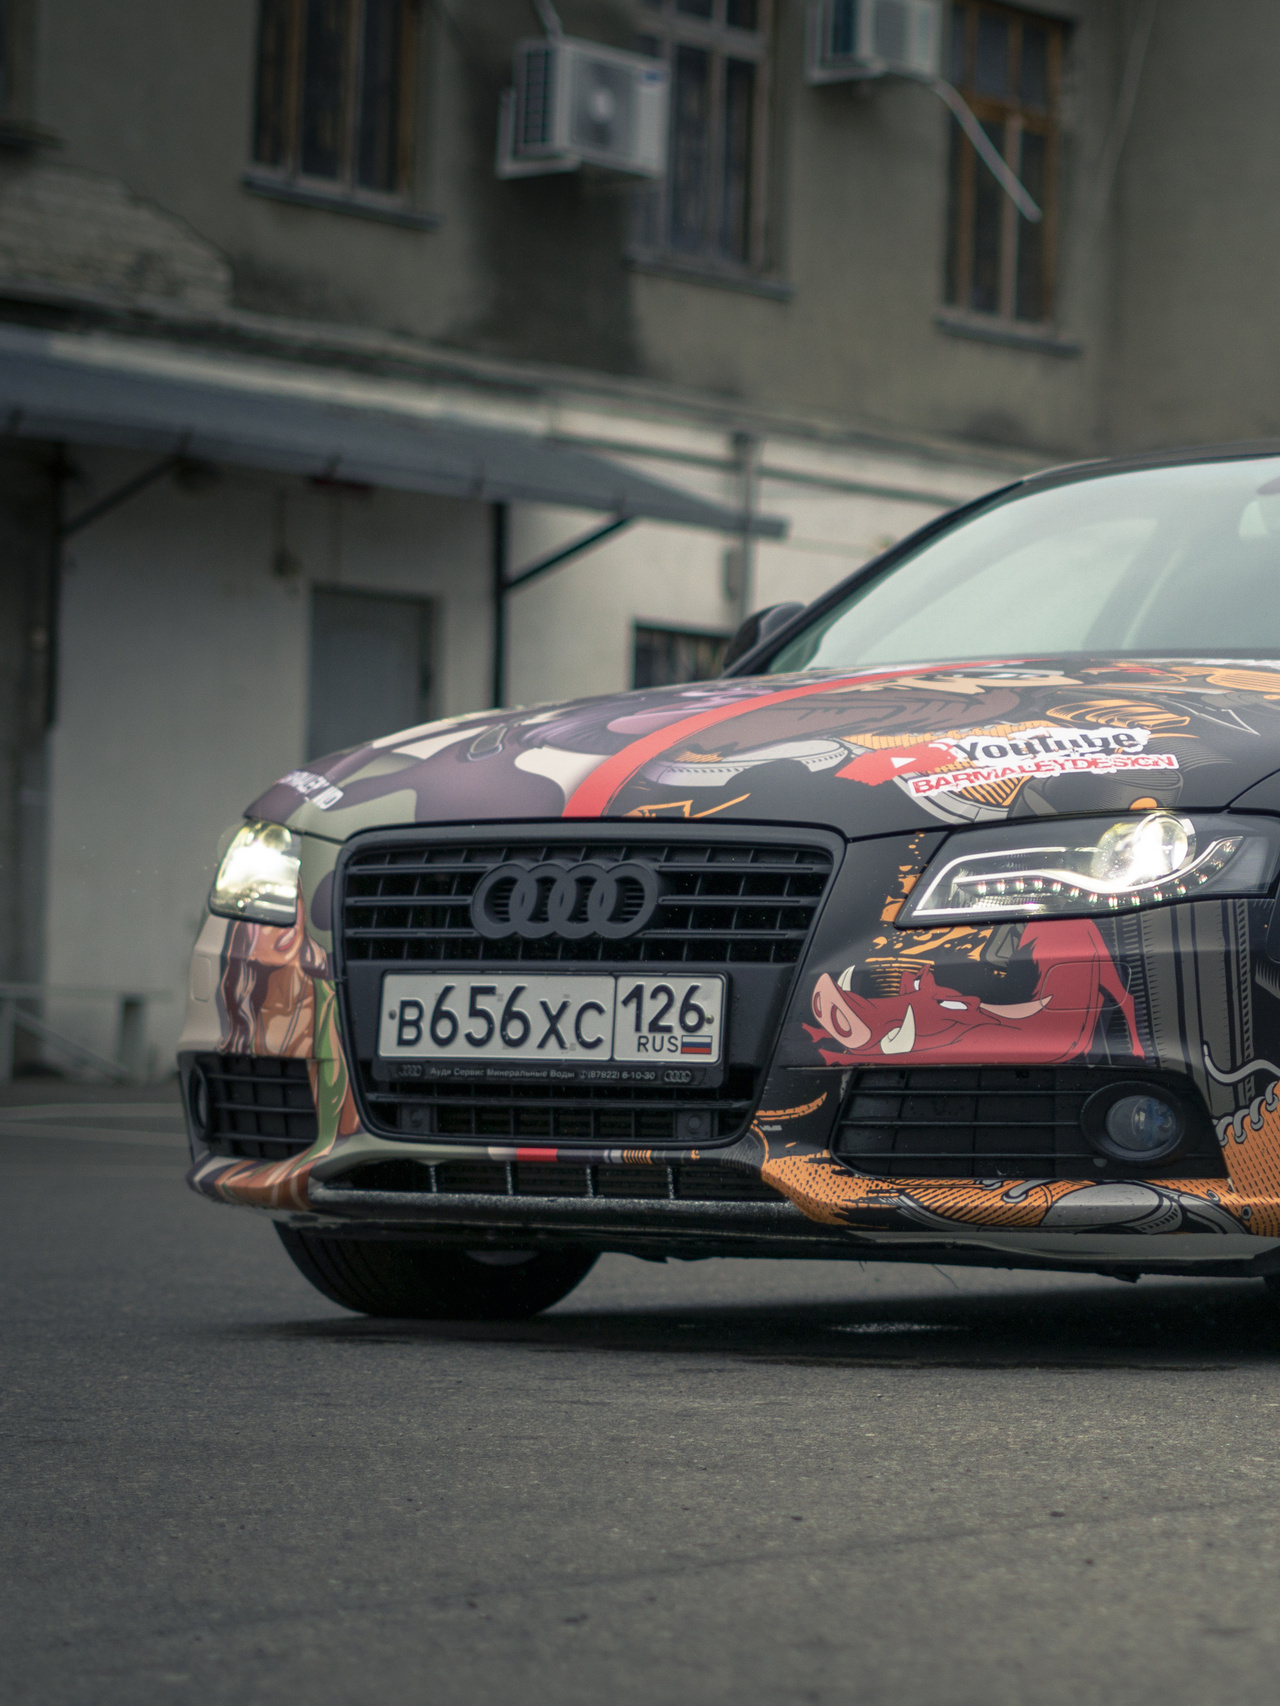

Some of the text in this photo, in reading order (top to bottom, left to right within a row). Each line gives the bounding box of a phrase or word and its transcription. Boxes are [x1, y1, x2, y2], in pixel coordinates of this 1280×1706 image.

[955, 731, 1140, 760] YouTube
[913, 755, 1175, 794] BARMALEYDESIGN
[621, 983, 706, 1033] 126
[637, 1035, 679, 1052] RUS
[454, 1067, 484, 1078] Сервис
[486, 1068, 547, 1078] Минеральные
[550, 1069, 575, 1079] Воды
